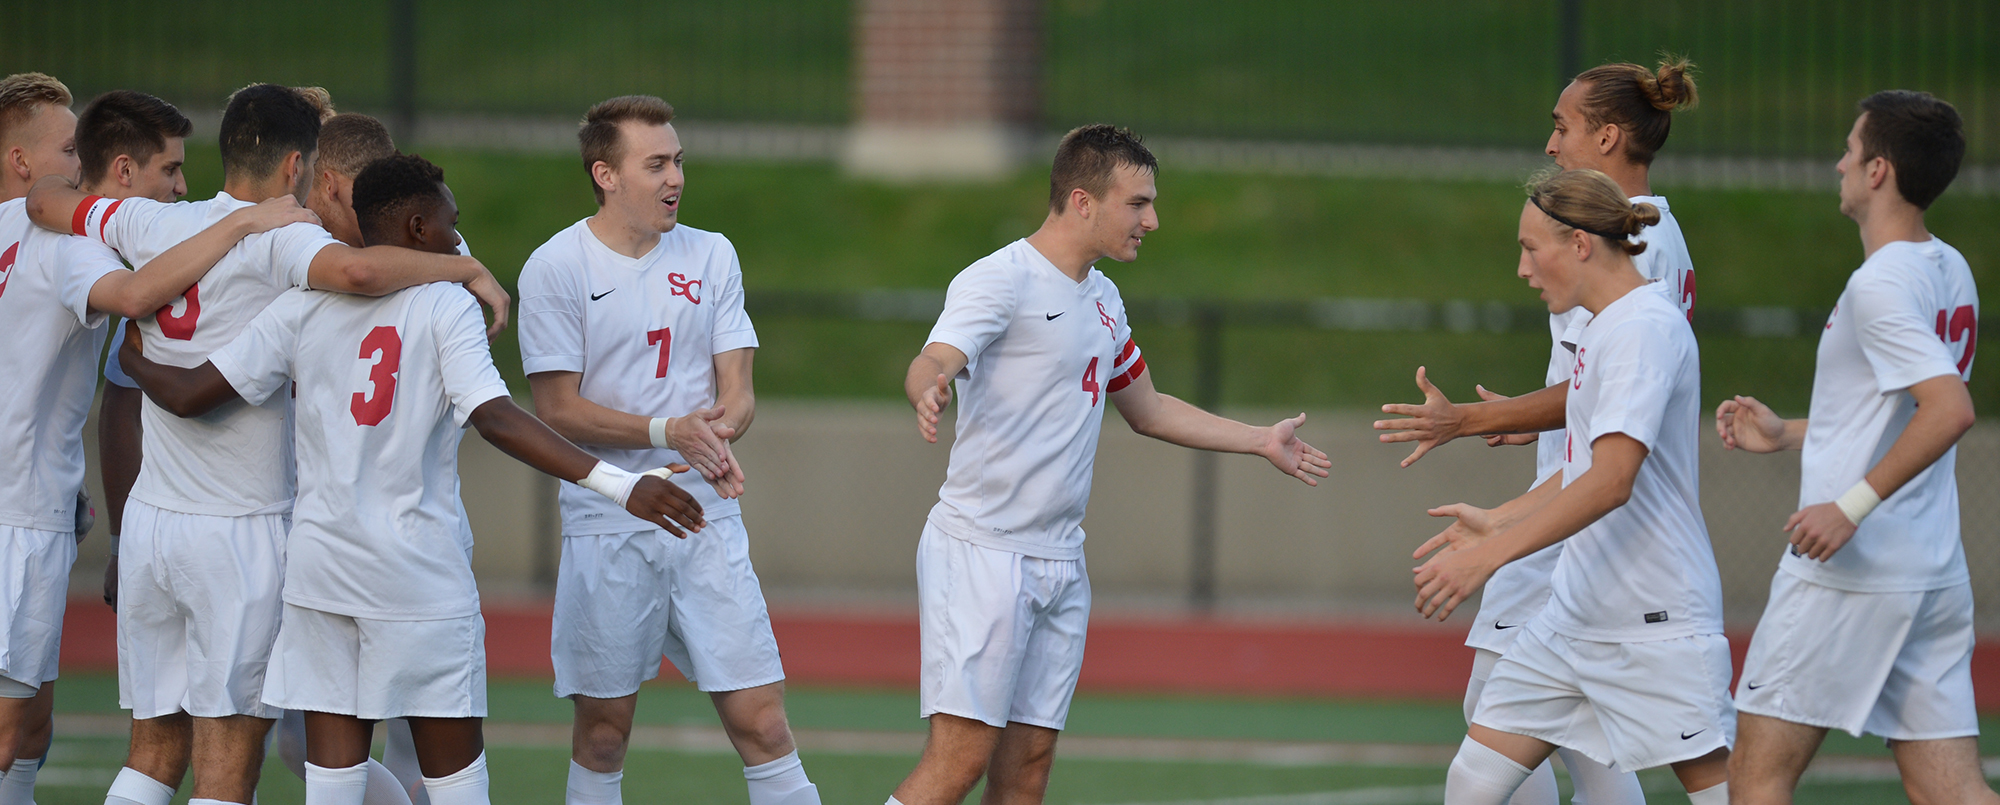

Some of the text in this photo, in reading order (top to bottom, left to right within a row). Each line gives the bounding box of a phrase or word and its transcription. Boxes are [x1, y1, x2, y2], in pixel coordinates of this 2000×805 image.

[667, 272, 702, 305] SC
[1096, 301, 1117, 341] SC
[350, 325, 402, 427] 3
[647, 326, 671, 379] 7
[1082, 356, 1100, 408] 4
